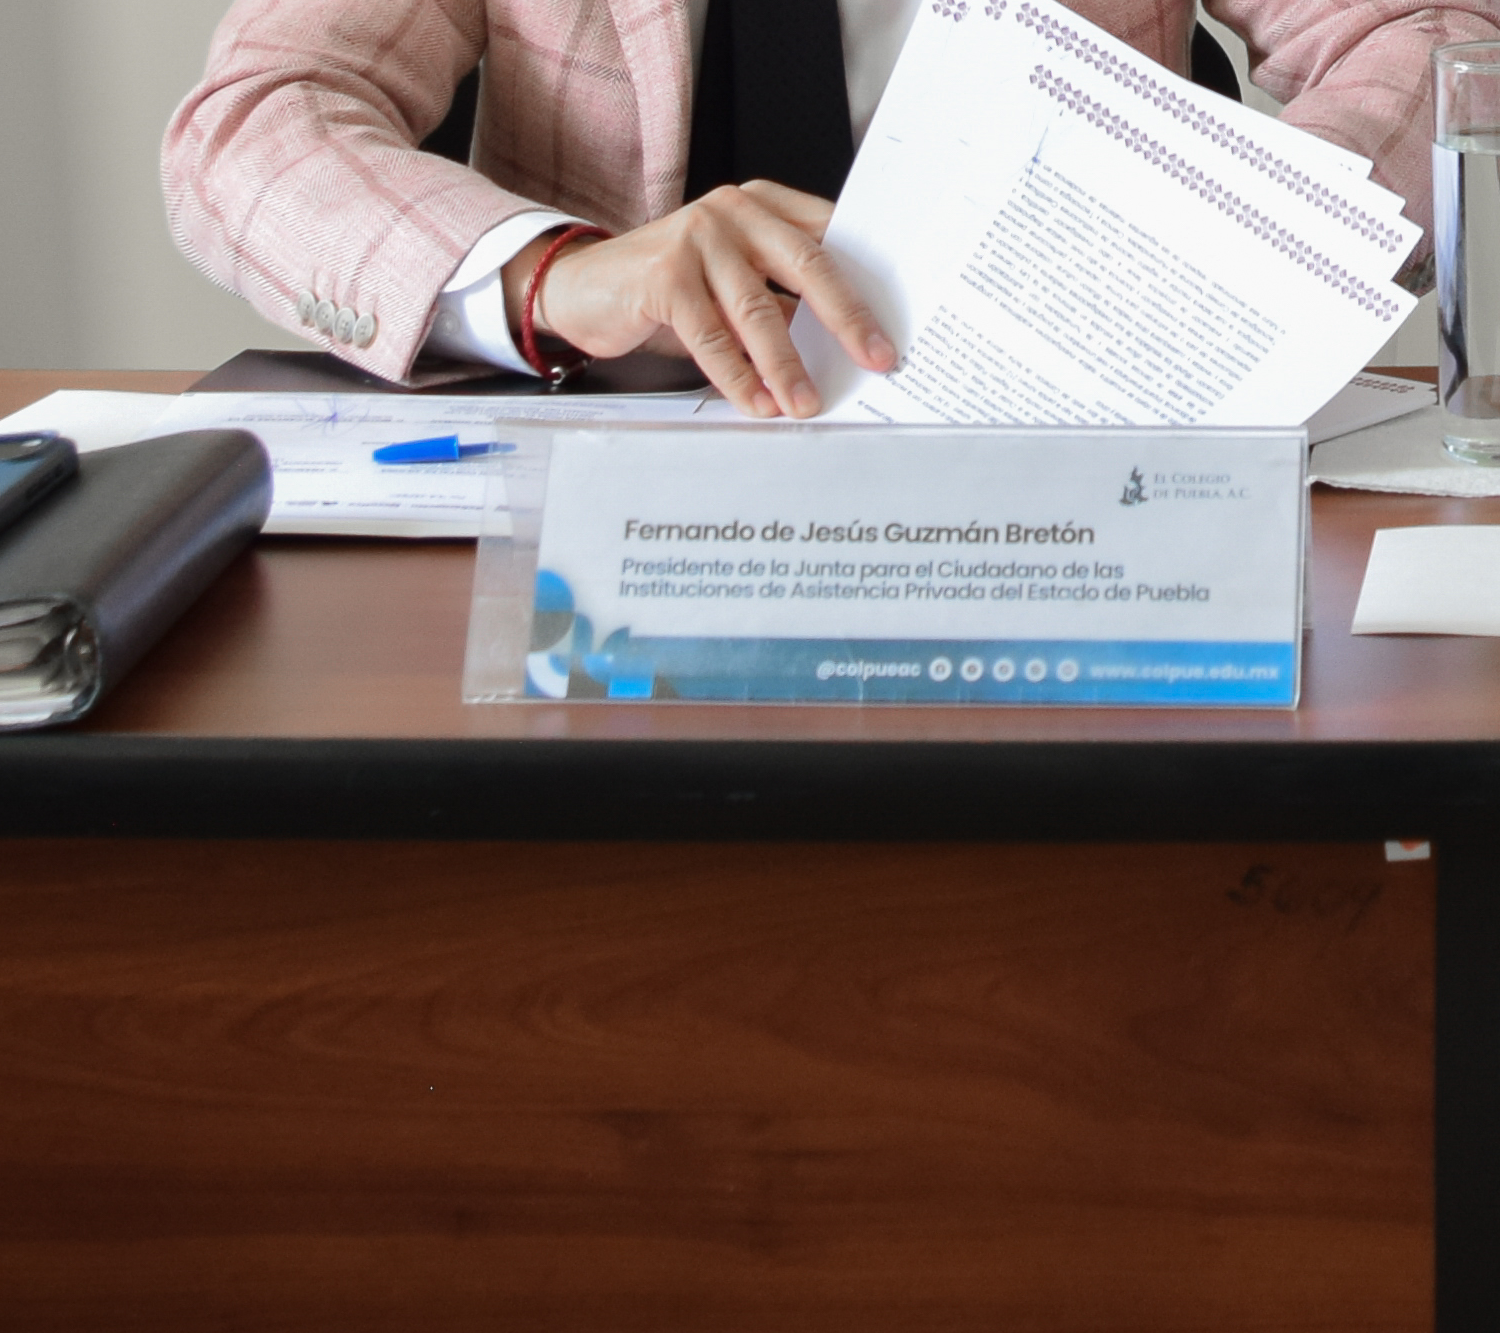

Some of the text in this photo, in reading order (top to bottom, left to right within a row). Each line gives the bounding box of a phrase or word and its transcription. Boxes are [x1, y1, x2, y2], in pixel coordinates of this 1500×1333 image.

[623, 519, 1095, 545] Fernando de Jesús Guzmán Bretón
[621, 556, 1125, 583] Presidente de la Junta para el Ciudadano de las
[618, 578, 1212, 604] Instituciones de Asistencia Privada del Estado de Puebla
